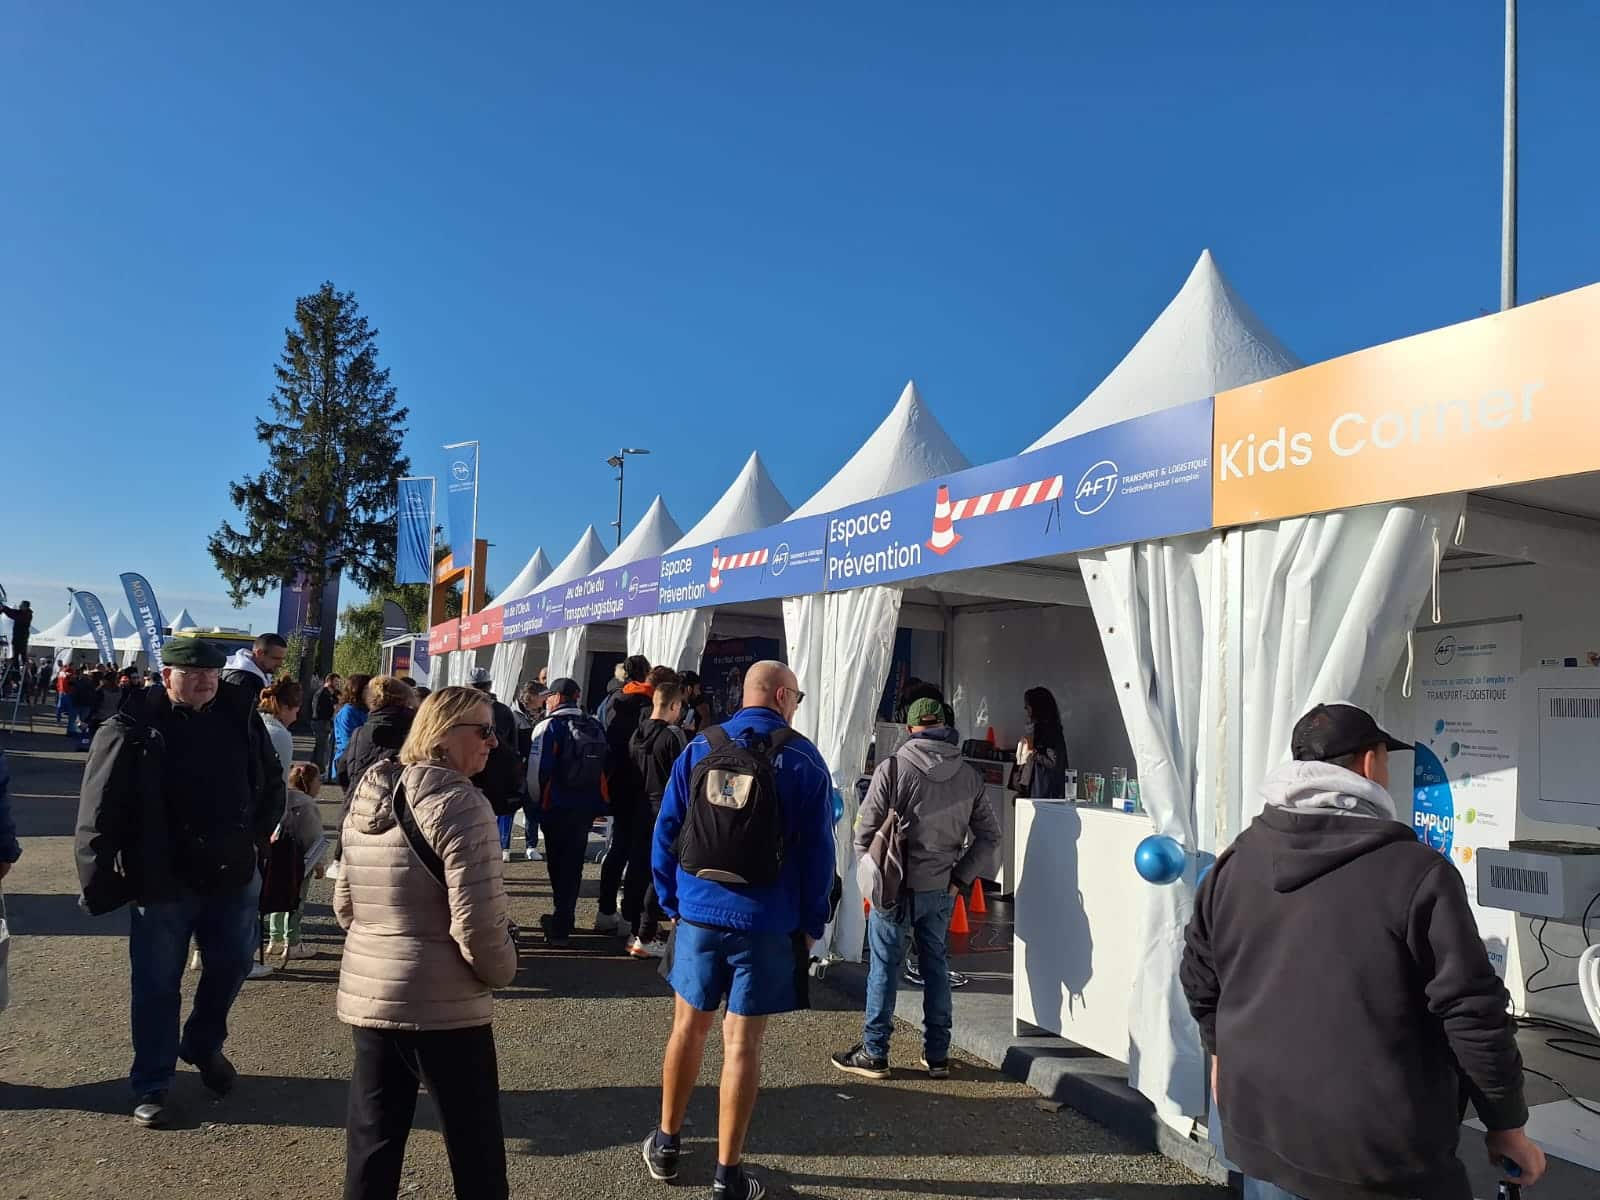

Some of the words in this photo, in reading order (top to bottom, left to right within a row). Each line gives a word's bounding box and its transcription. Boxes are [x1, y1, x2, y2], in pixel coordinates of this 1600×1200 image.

[1219, 426, 1312, 481] Kids
[1328, 381, 1546, 457] Corner
[1122, 469, 1158, 485] TRANSPORT
[1168, 457, 1208, 474] LOGISTIQUE
[1076, 473, 1119, 500] AFT
[830, 508, 892, 547] Espace
[660, 557, 692, 581] Espace
[772, 551, 789, 565] AFT
[829, 542, 921, 581] Prévention
[575, 583, 583, 597] de
[595, 577, 604, 592] du
[659, 580, 705, 604] Prévention
[564, 596, 624, 622] Transport-Logistique
[1427, 688, 1507, 701] TRANSPORT-LOGISTIQUE
[1415, 811, 1454, 833] EMPLOI
